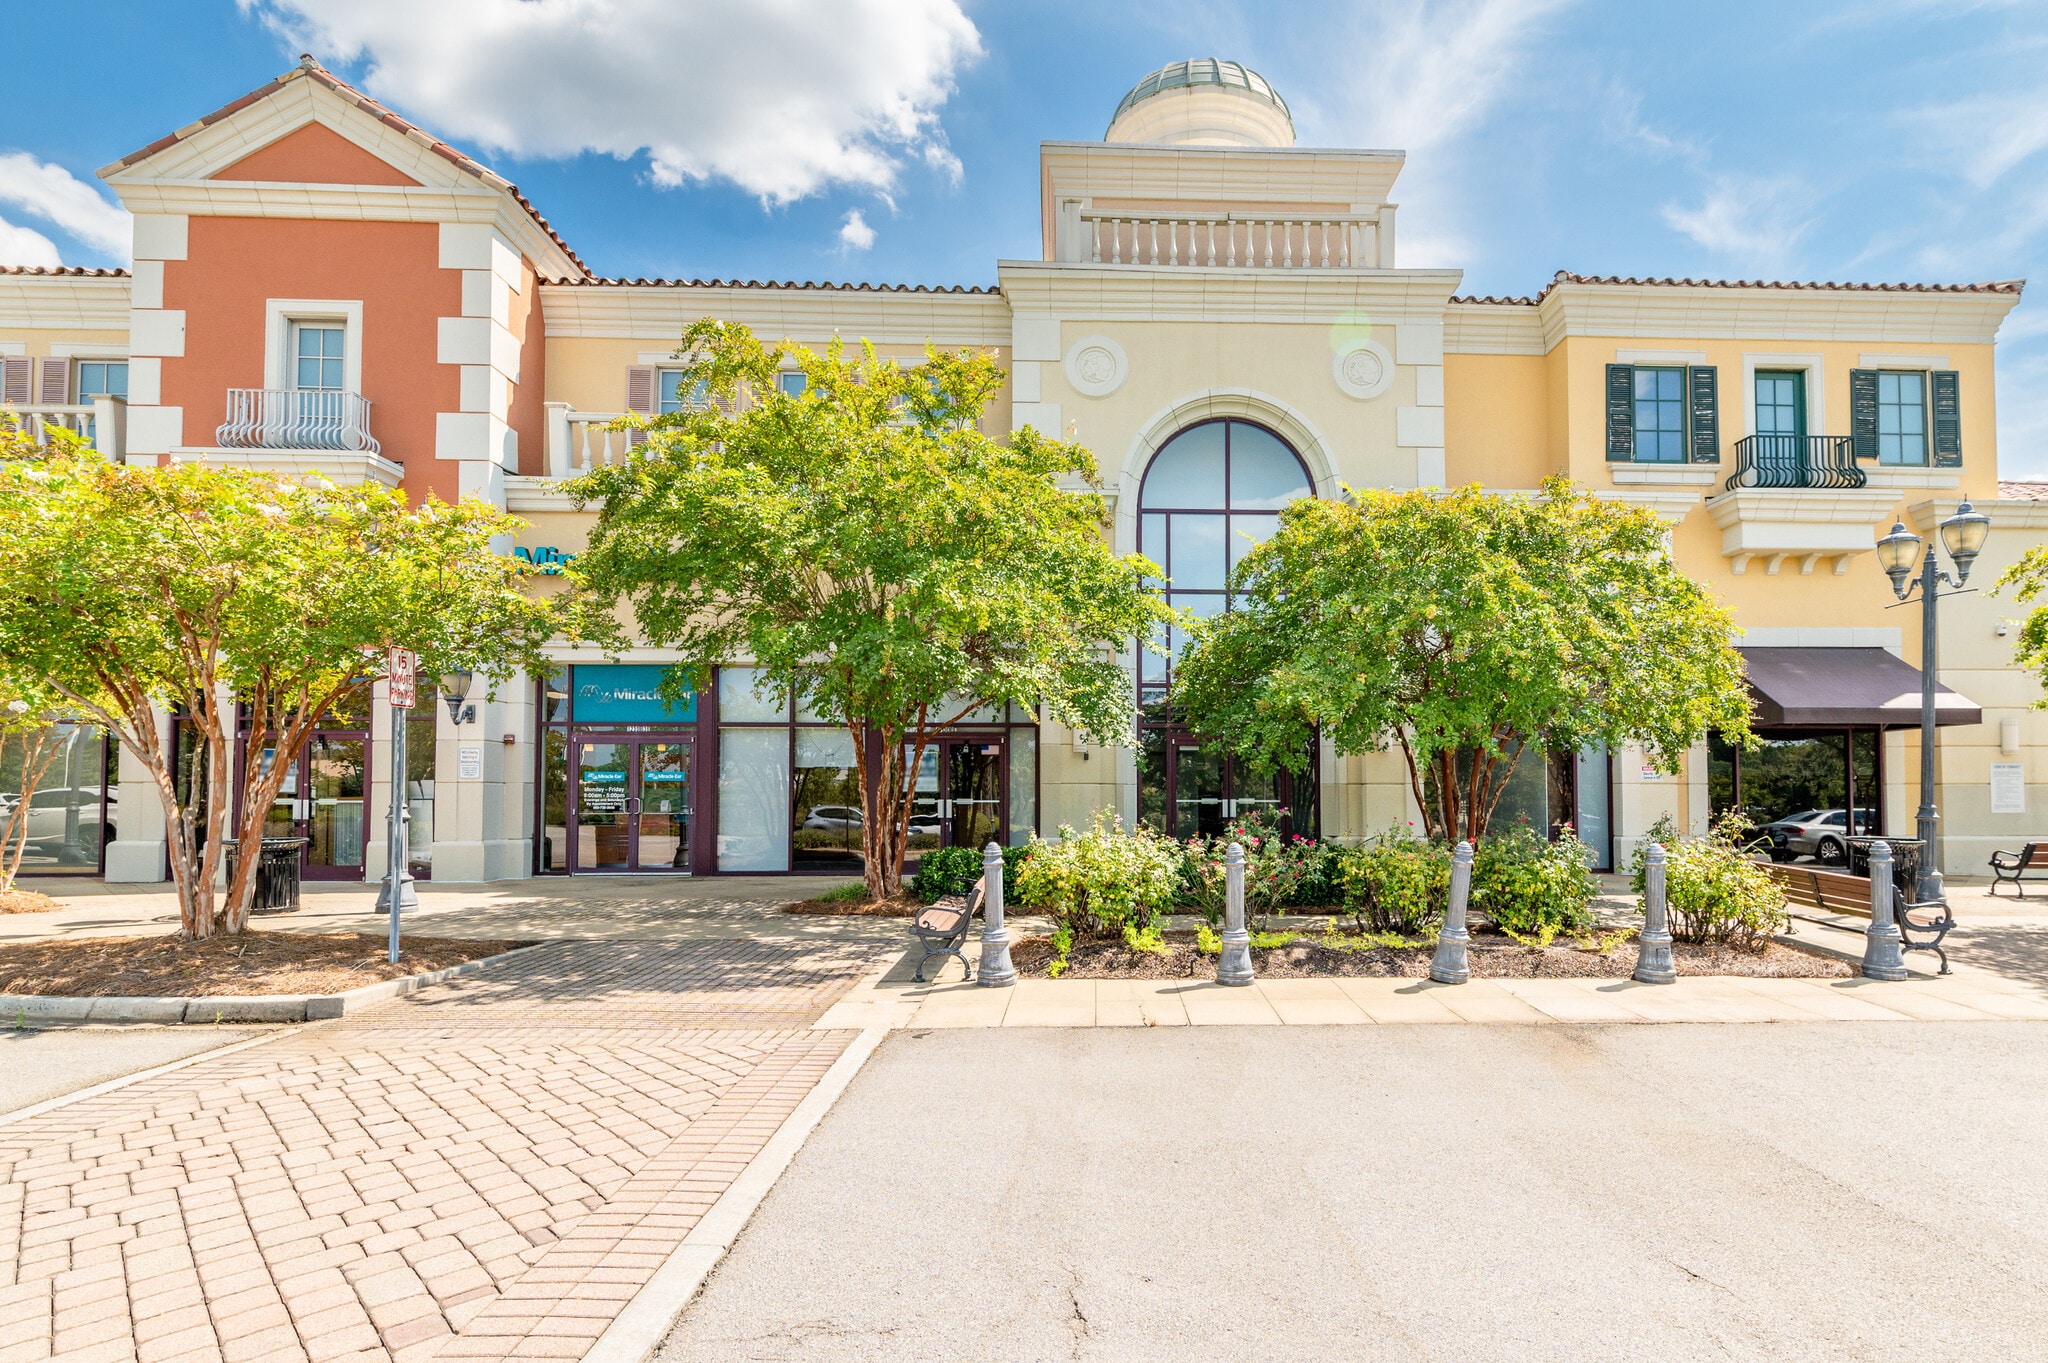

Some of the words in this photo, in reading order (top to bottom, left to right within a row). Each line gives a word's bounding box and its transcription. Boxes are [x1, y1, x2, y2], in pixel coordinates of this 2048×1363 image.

[398, 655, 407, 669] 15
[392, 672, 412, 685] MINUTE
[392, 688, 413, 700] PARKING
